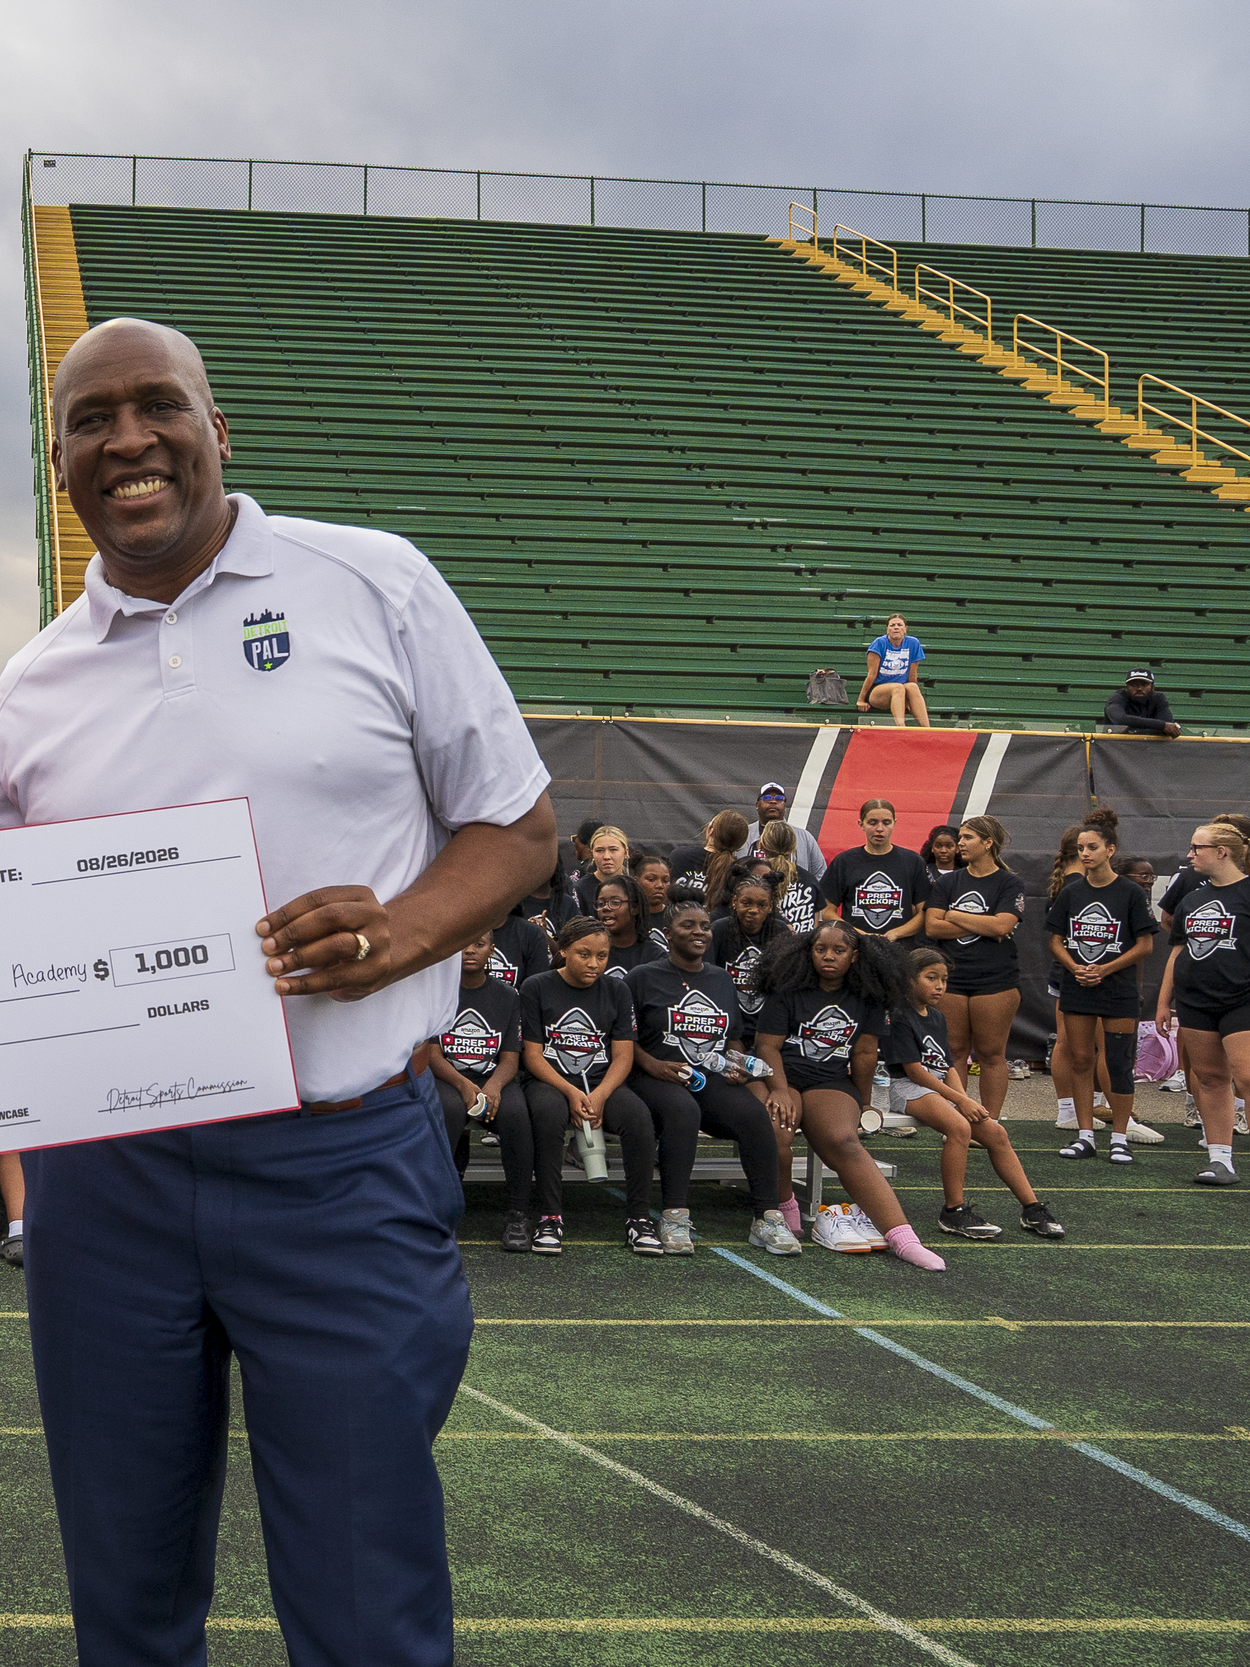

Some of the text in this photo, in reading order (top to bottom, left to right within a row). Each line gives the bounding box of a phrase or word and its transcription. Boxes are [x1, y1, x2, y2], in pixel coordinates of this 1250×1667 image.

[243, 620, 287, 640] DETROIT
[251, 637, 289, 669] PAL
[76, 847, 180, 872] 08/26/2026
[783, 886, 813, 909] IRLS
[858, 898, 899, 906] KICKOFF
[784, 903, 815, 922] STLE
[792, 918, 815, 934] DER
[1073, 930, 1114, 939] KICKOFF
[1081, 924, 1107, 932] PREP
[1186, 926, 1228, 935] KICKOFF
[92, 943, 210, 982] $ 1,000
[12, 962, 87, 988] Academy
[147, 999, 210, 1019] DOLLARS
[685, 1016, 716, 1025] PREP
[674, 1024, 723, 1035] KICKOFF
[444, 1045, 497, 1055] KICKOFF
[454, 1038, 486, 1047] PREP
[107, 1076, 248, 1113] Detroit Sports Commission
